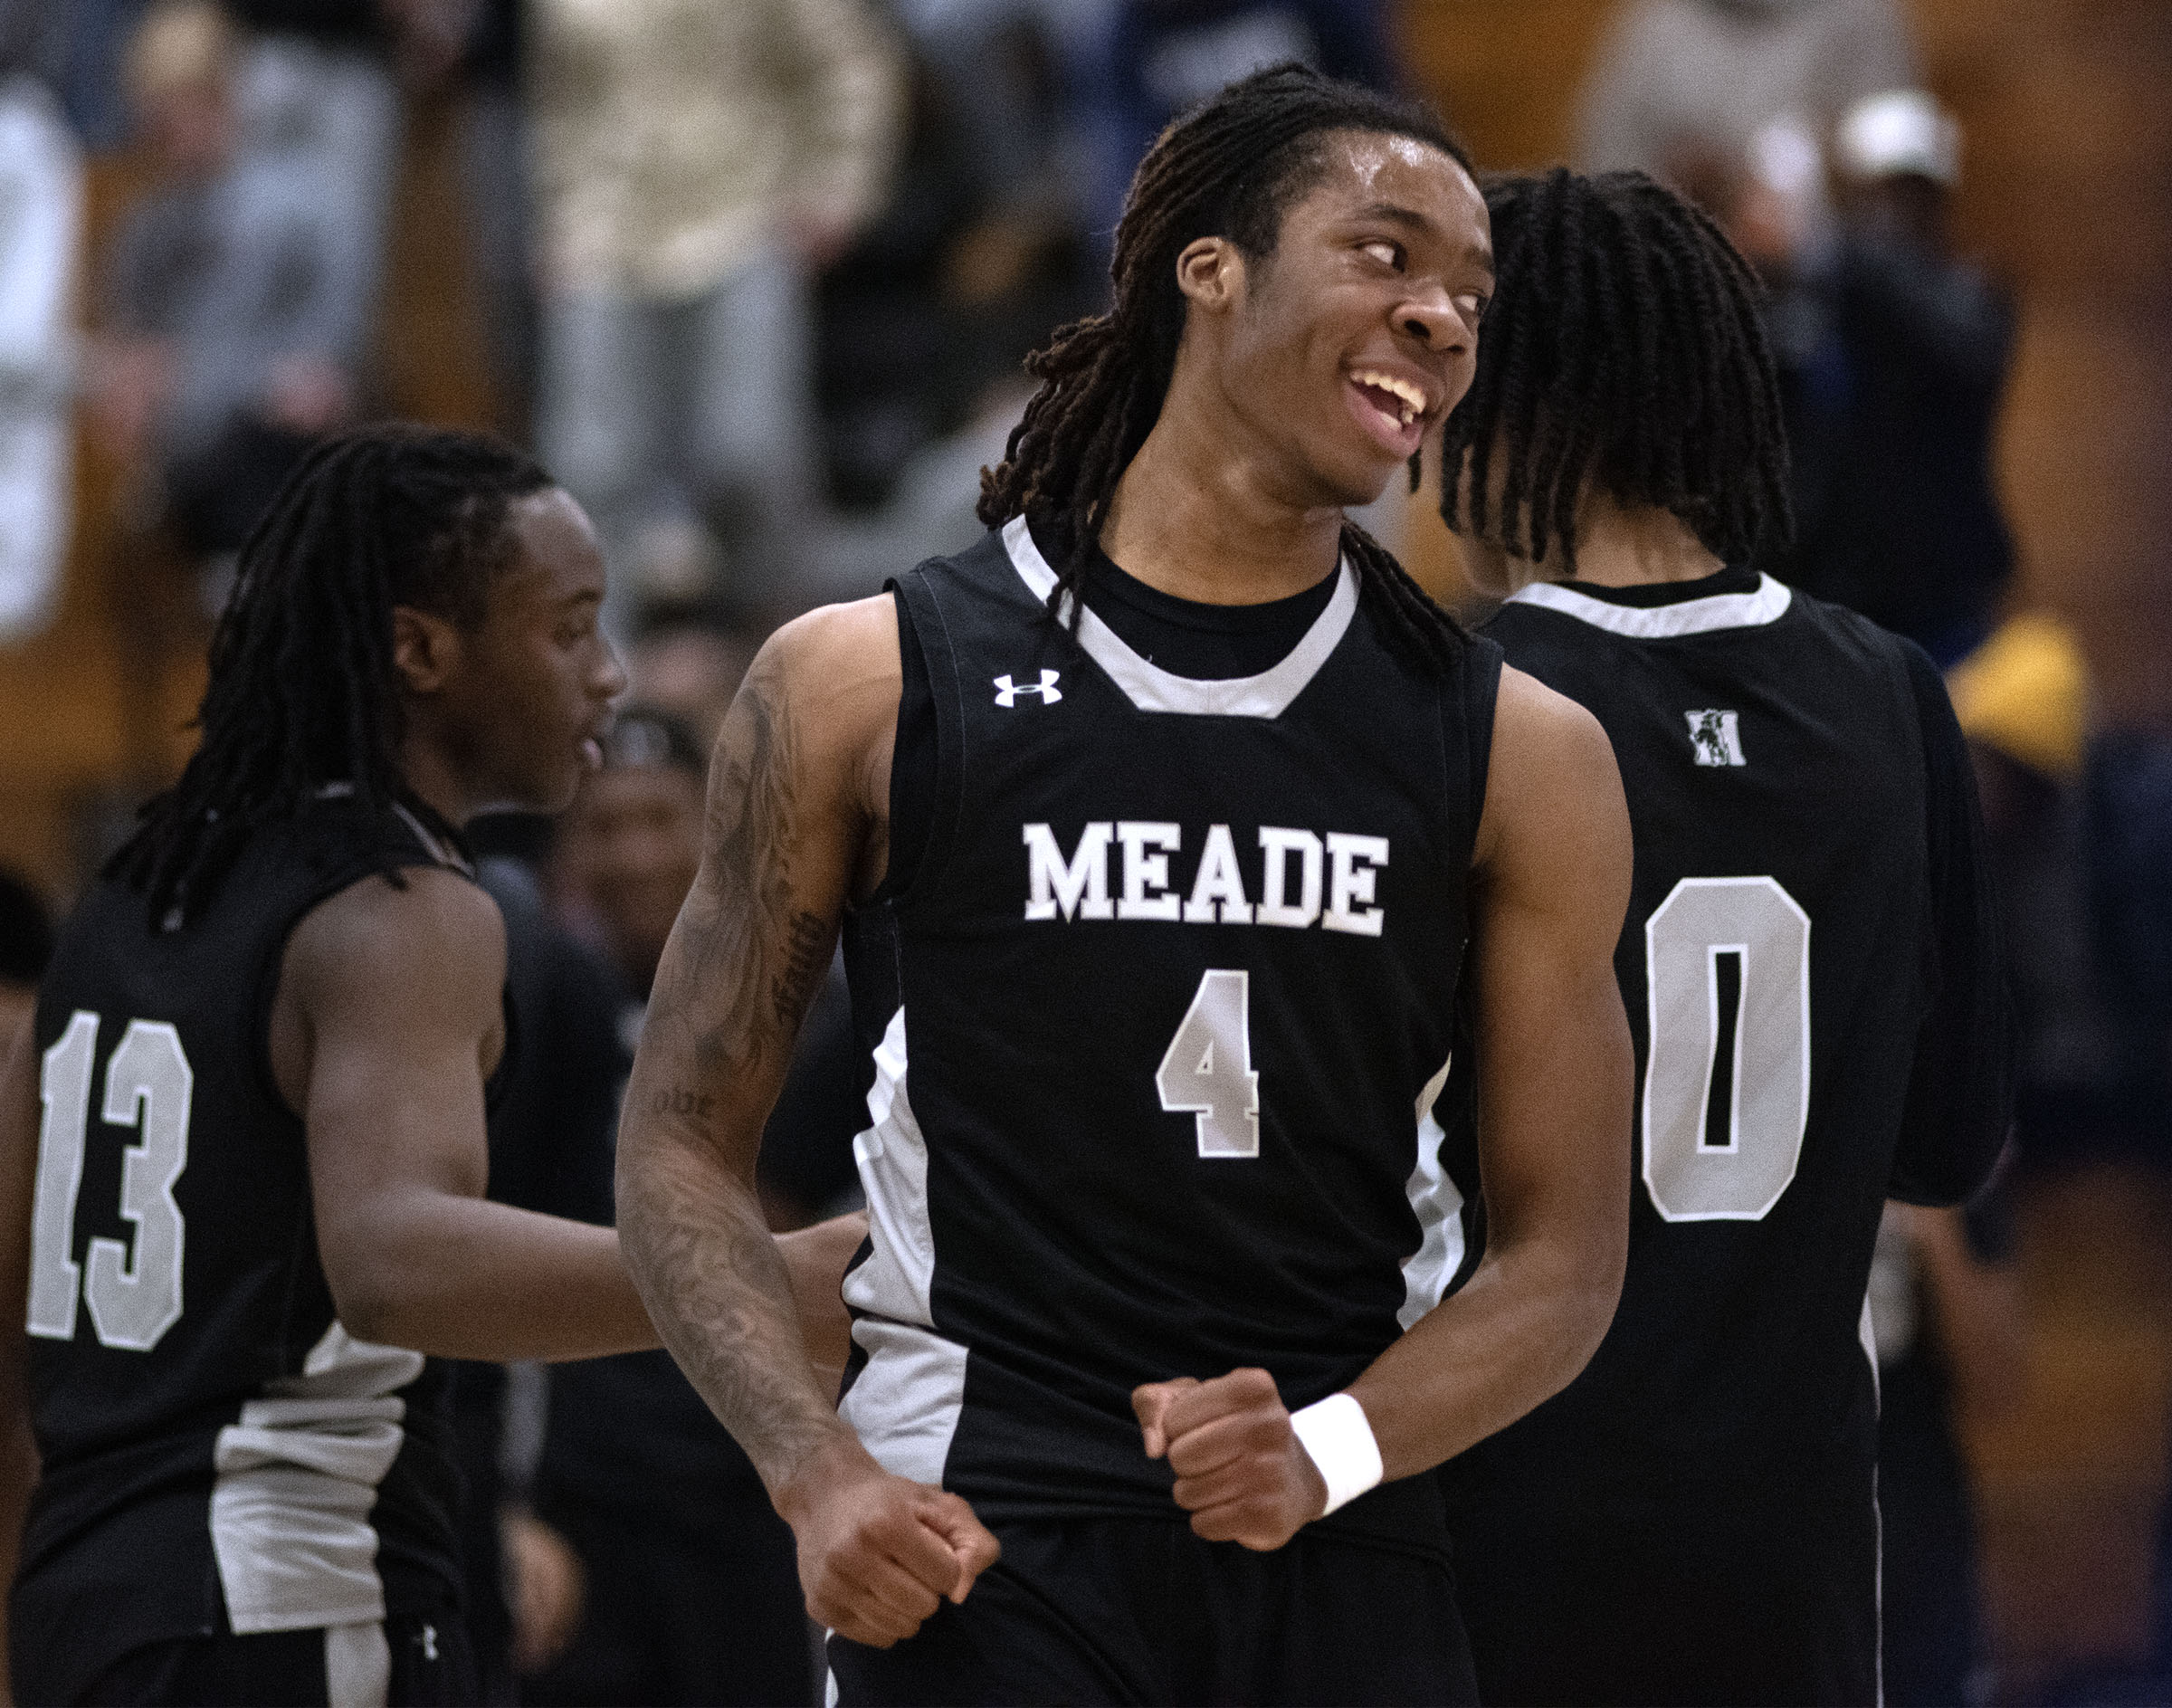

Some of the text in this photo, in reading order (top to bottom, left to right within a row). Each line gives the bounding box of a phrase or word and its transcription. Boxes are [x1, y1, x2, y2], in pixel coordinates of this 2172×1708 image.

[1024, 821, 1389, 937] MEADE
[25, 1008, 195, 1351] 13
[1155, 969, 1260, 1159] 4
[1642, 875, 1811, 1223] 0
